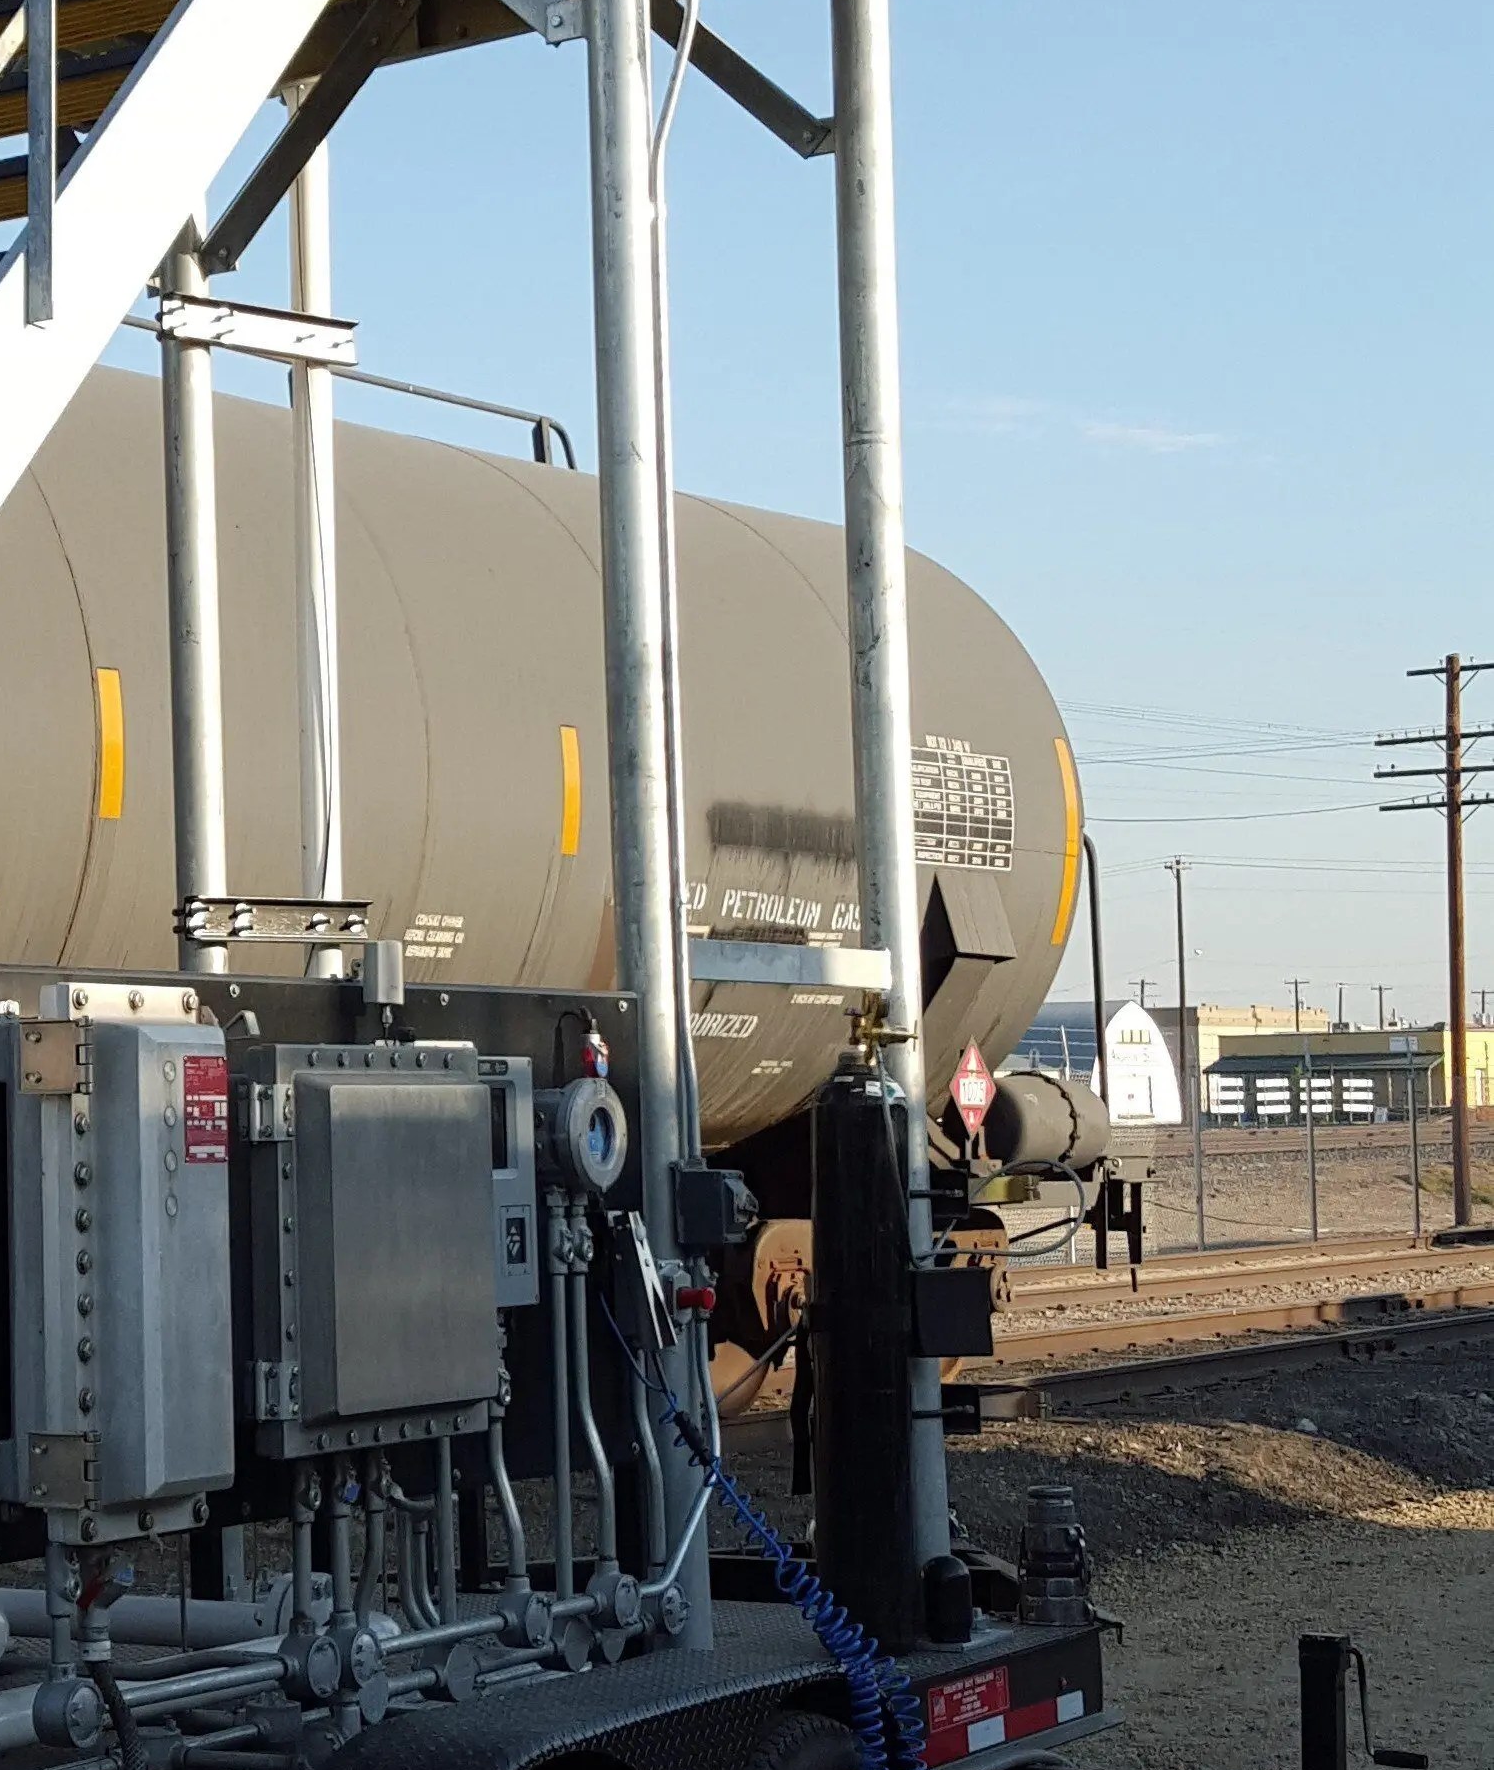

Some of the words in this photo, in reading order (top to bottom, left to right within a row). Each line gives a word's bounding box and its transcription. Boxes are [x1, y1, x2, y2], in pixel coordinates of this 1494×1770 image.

[684, 882, 707, 910] ED
[721, 888, 822, 929] PETROLEUM
[831, 902, 861, 931] GAS
[690, 1012, 758, 1038] DORIZED
